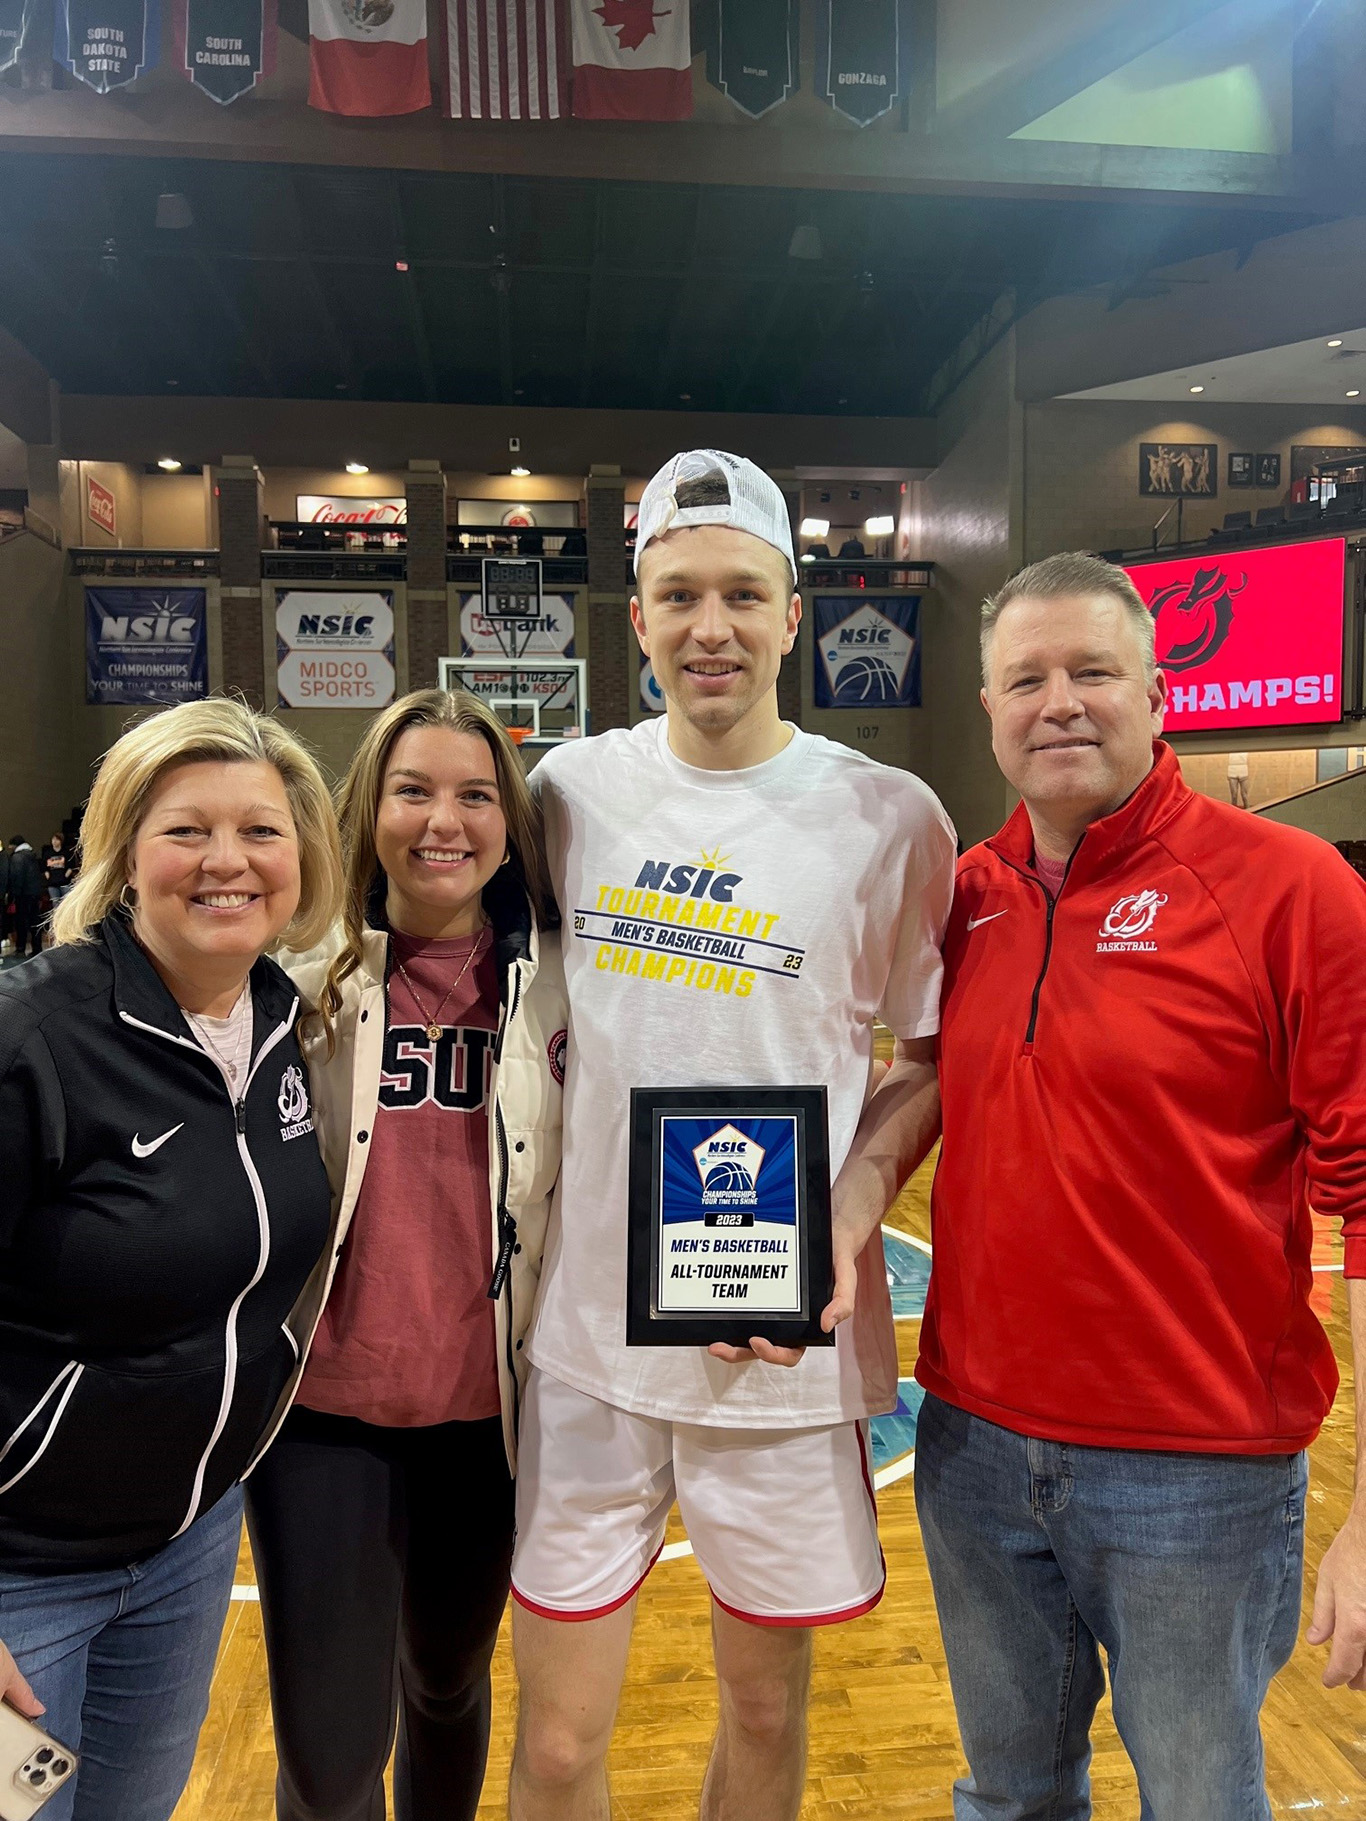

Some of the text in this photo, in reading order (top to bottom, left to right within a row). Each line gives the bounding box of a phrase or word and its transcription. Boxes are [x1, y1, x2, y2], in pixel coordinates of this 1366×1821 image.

[87, 27, 124, 42] SOUTH
[205, 36, 242, 50] SOUTH
[83, 43, 127, 59] DAKOTA
[195, 51, 251, 66] CAROLINA
[88, 59, 121, 73] STATE
[838, 73, 886, 86] GONZAGA
[100, 616, 196, 641] NSIC
[298, 615, 374, 636] NSIC
[838, 629, 892, 643] NSIC
[108, 664, 188, 677] CHAMPIONSHIPS
[300, 662, 367, 678] MIDCO
[92, 681, 123, 691] YOUR
[154, 683, 168, 691] TO
[171, 681, 203, 692] SHINE
[300, 681, 376, 697] SPORTS
[1164, 674, 1335, 714] HAMPS!
[857, 727, 878, 739] 107
[634, 859, 744, 903] NSIC
[596, 885, 781, 941] TOURNAMENT
[574, 916, 586, 930] 20
[611, 921, 747, 960] MEN'S BASKETBALL
[1096, 941, 1158, 953] BASKETBALL
[783, 954, 804, 970] 23
[595, 943, 757, 998] CHAMPIONS
[708, 1142, 747, 1153] NSIC
[701, 1197, 718, 1205] YOUR
[740, 1197, 758, 1205] SHINE
[702, 1190, 757, 1199] CHAMPIONSHIPS
[715, 1214, 743, 1226] 2023
[670, 1239, 789, 1253] MEN'S BASKETBALL
[493, 1241, 511, 1292] CANADA GOOSE
[670, 1264, 788, 1279] ALL-TOURNAMENT
[712, 1283, 748, 1298] TEAM
